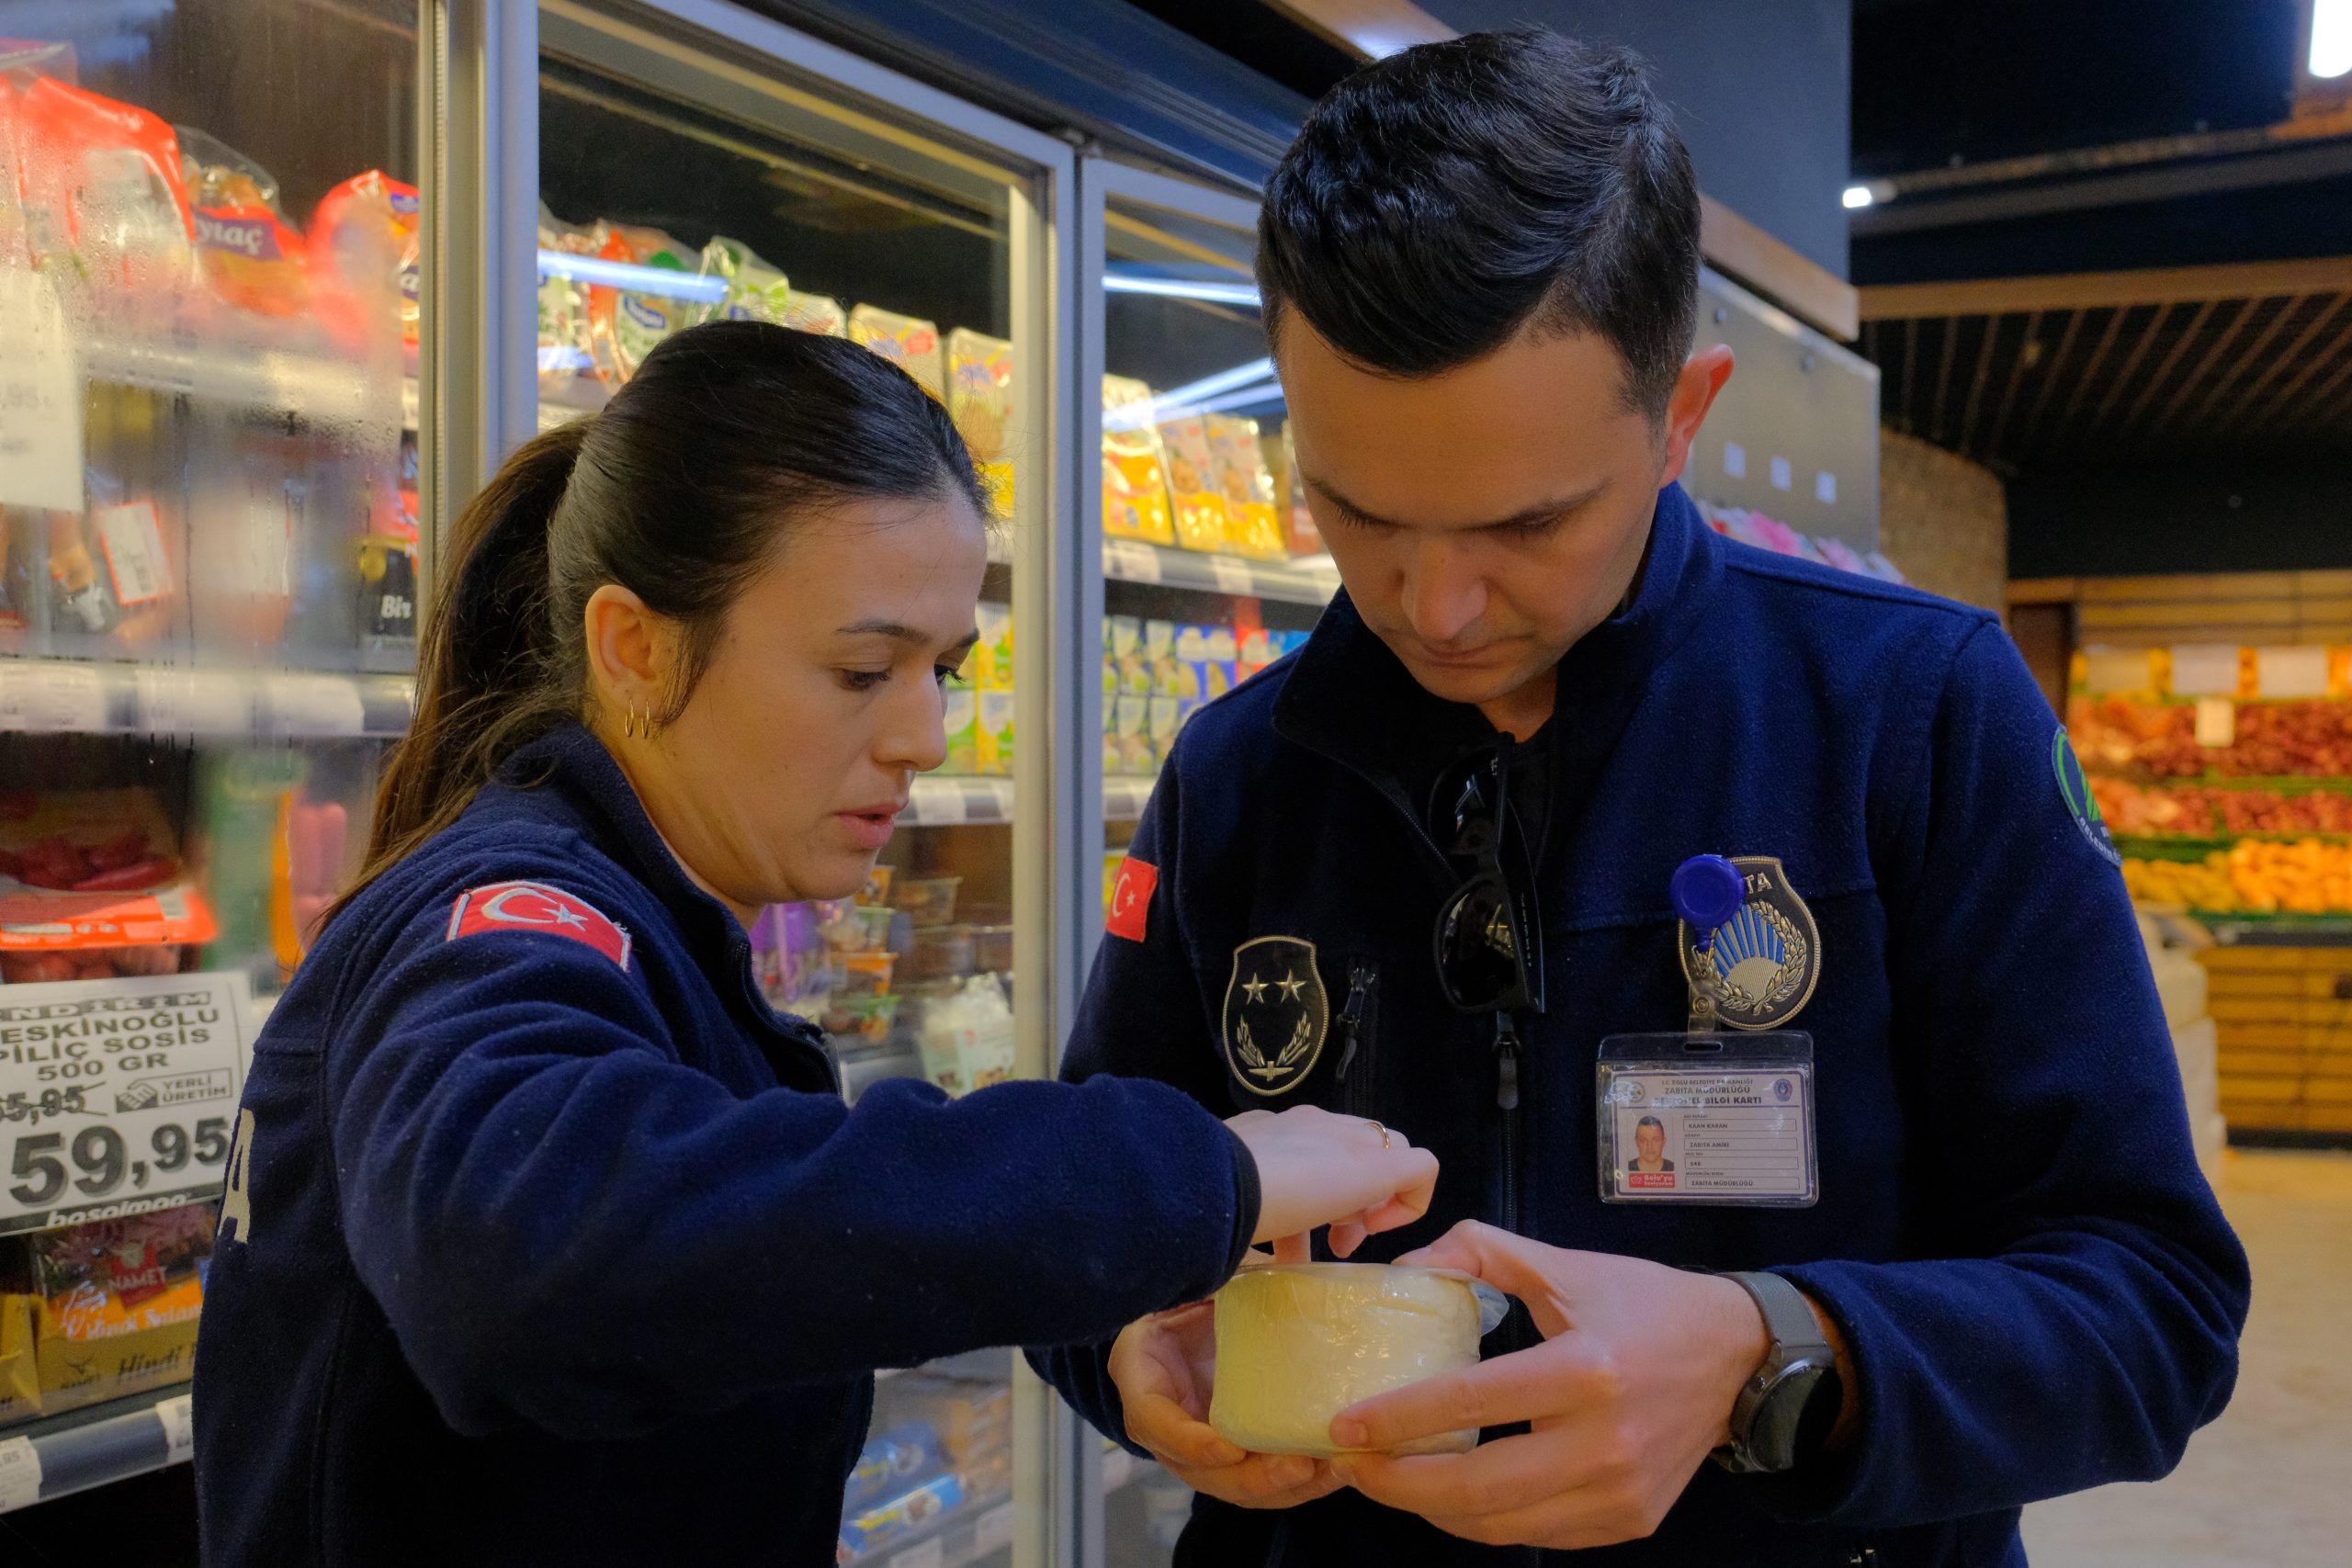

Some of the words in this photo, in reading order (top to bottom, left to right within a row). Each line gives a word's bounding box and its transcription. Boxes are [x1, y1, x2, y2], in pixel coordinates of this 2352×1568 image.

[1744, 872, 1773, 895] TA
[104, 1028, 211, 1054] SOSİS
[38, 1059, 104, 1082] 500
[119, 1053, 170, 1073] GR
[162, 1074, 212, 1090] YERLİ
[1664, 1087, 1693, 1095] ZABITA
[0, 1085, 86, 1126] 5,95
[163, 1087, 227, 1104] ÜRETİM
[1705, 1096, 1730, 1104] BİLGİ
[9, 1117, 231, 1208] 59,95
[107, 1266, 168, 1292] NAMET
